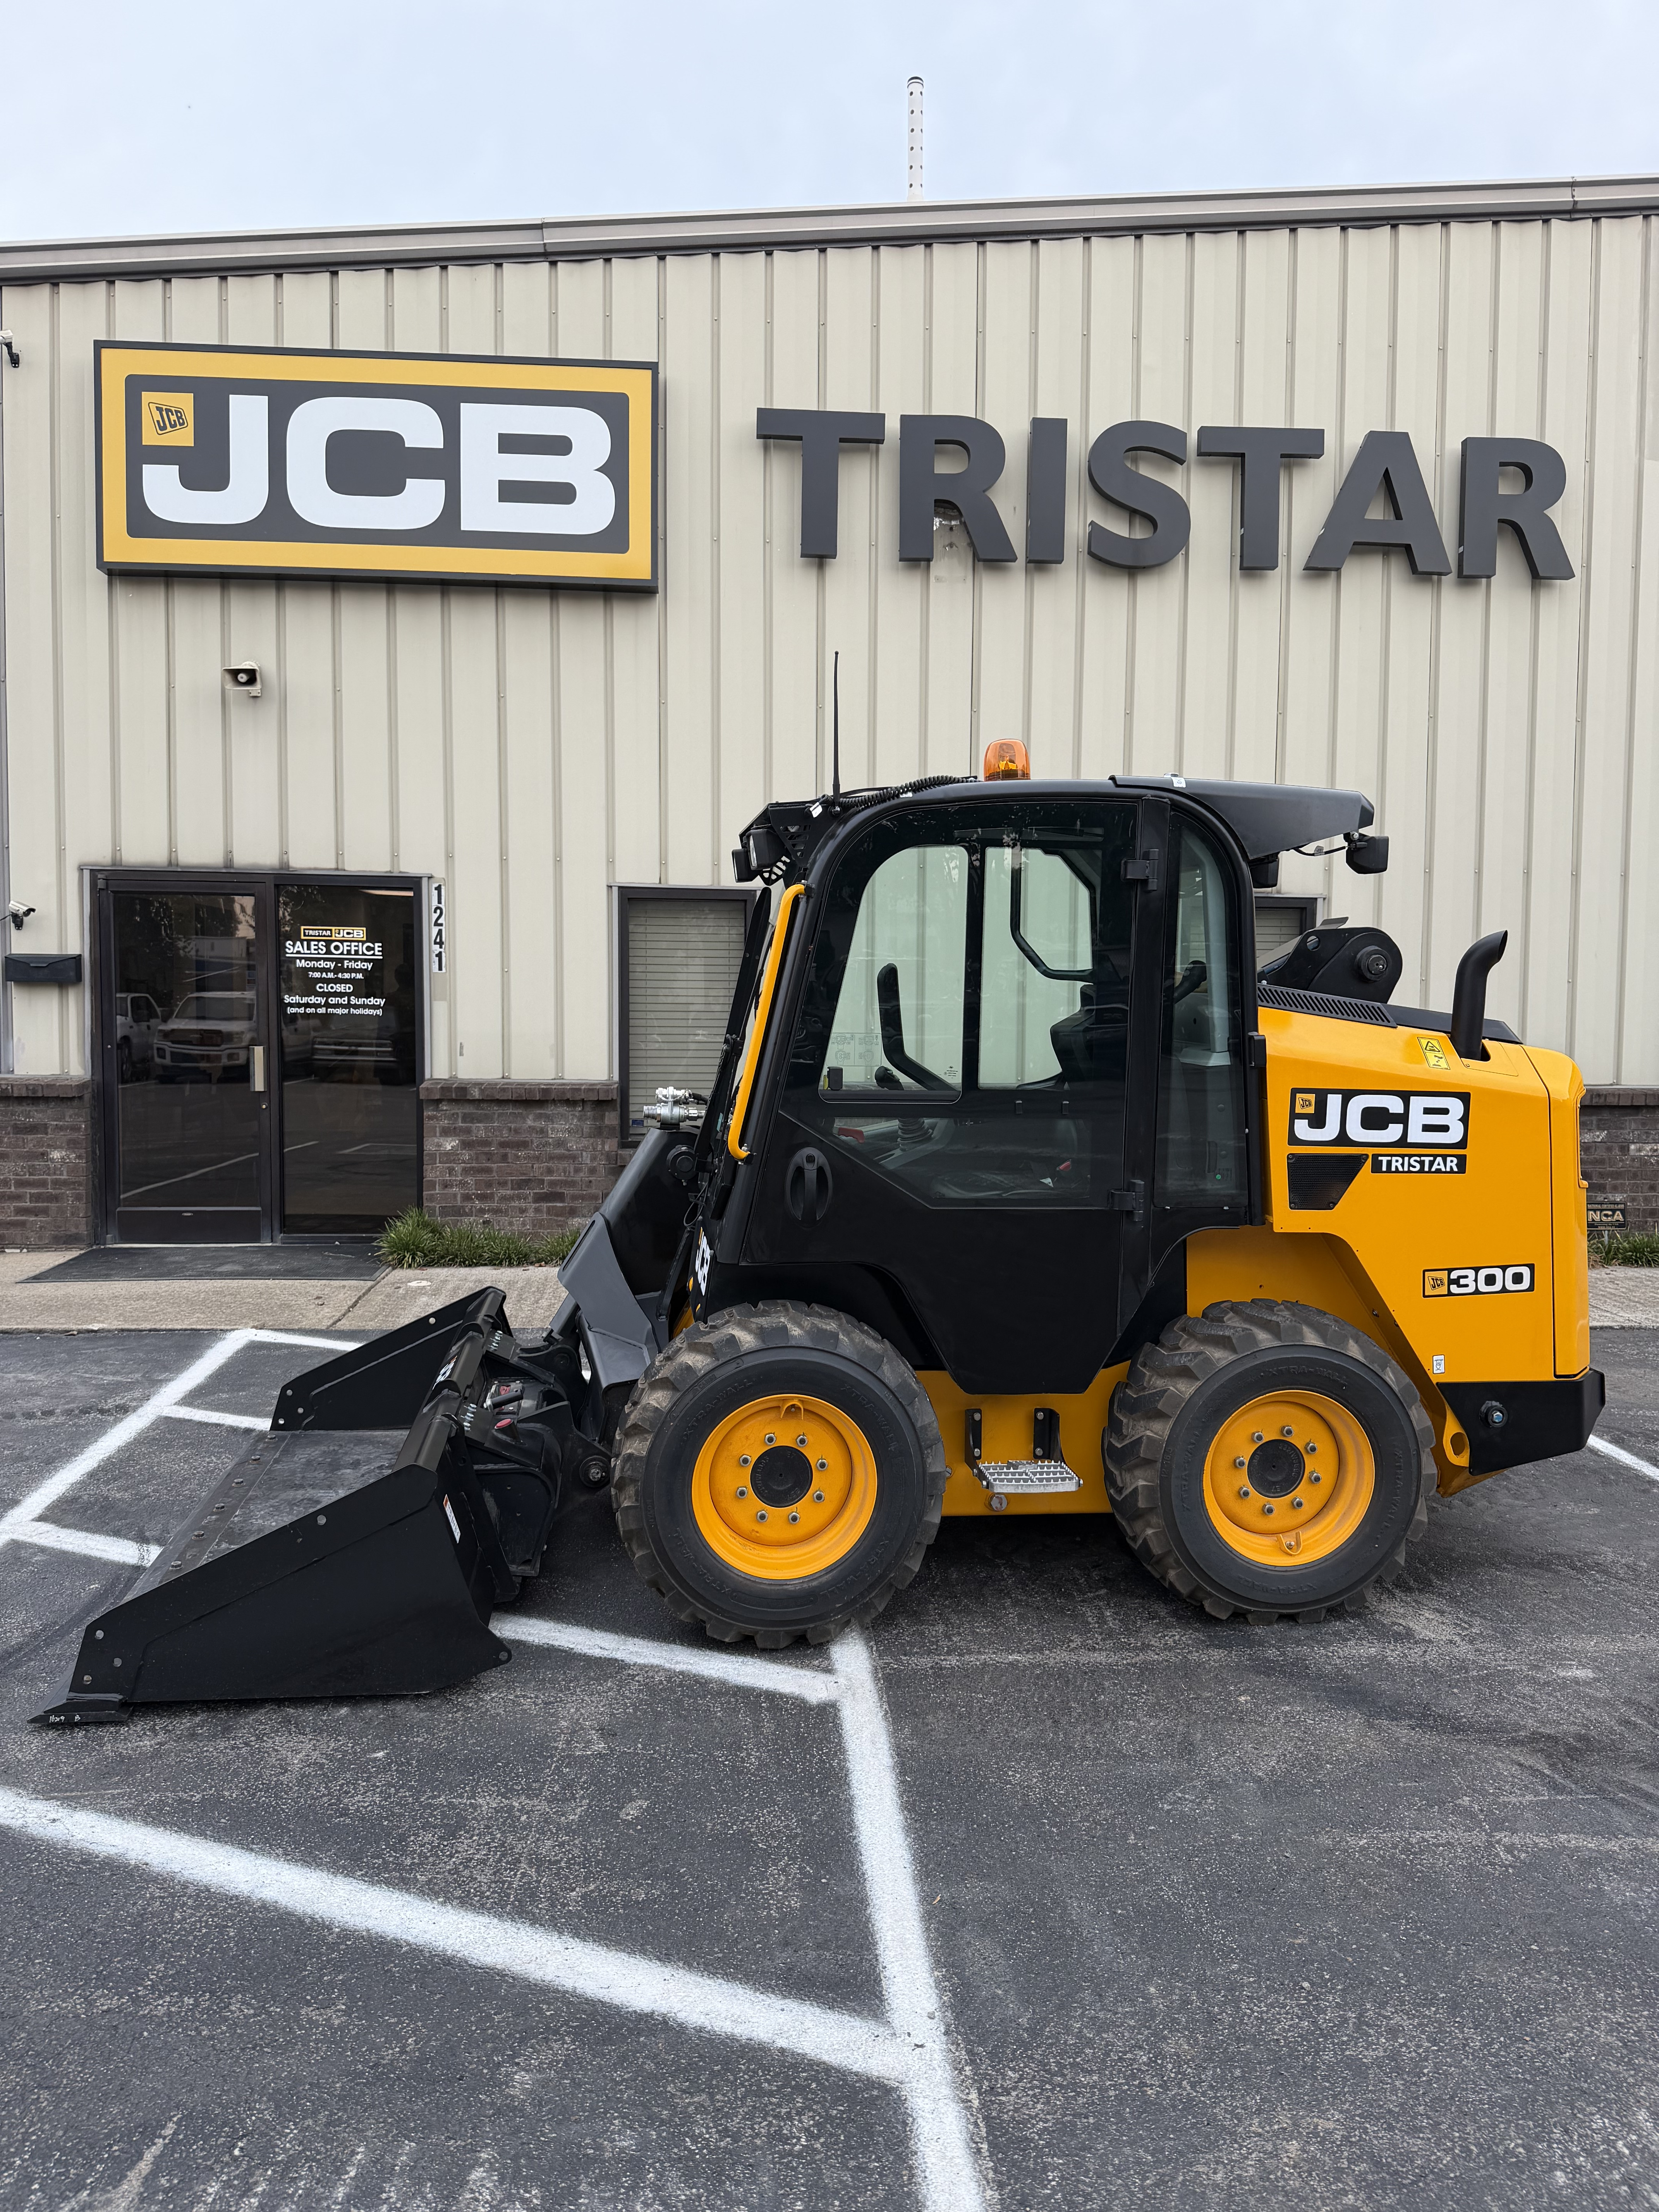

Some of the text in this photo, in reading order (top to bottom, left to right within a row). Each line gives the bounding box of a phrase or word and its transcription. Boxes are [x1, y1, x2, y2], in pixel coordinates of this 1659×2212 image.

[155, 405, 187, 430] JCB
[142, 394, 616, 535] JCB
[756, 407, 1577, 581] TRISTAR
[335, 929, 364, 938] JCB
[433, 883, 445, 972] 1241
[285, 941, 382, 955] SALES OFFICE
[296, 959, 335, 970] Monday
[344, 960, 373, 970] Friday
[316, 983, 353, 992] CLOSED
[284, 995, 386, 1006] Saturday and Sunday
[1300, 1098, 1313, 1108] JCB
[1294, 1094, 1464, 1144] JCB
[1378, 1156, 1458, 1171] TRISTAR
[1587, 1211, 1625, 1221] NCA
[1431, 1266, 1530, 1294] JCB 300
